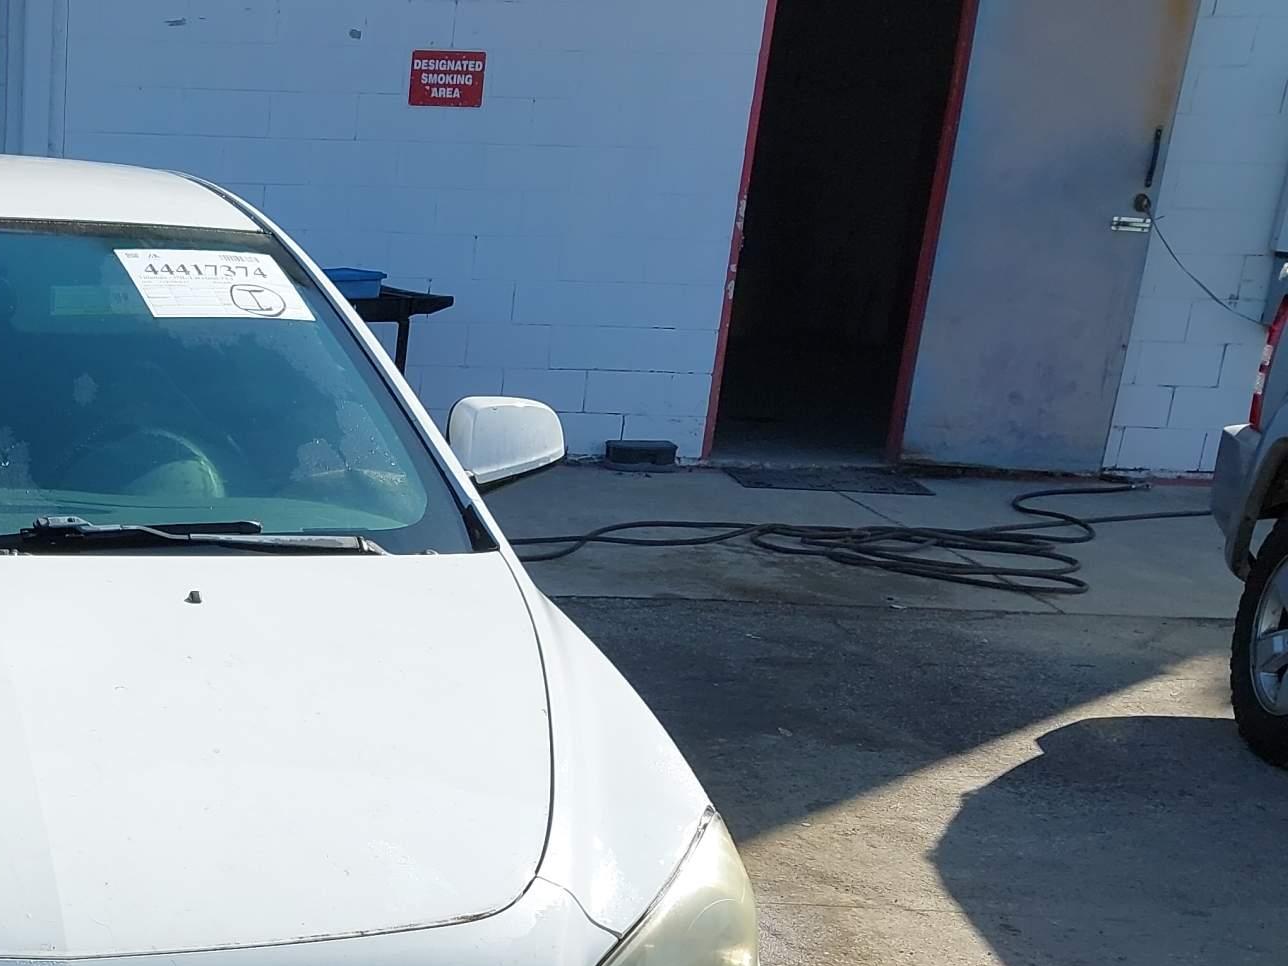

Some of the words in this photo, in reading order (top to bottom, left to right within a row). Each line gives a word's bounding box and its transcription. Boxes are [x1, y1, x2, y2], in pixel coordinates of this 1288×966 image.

[413, 59, 483, 72] DESIGNATED
[421, 73, 473, 85] SMOKING
[430, 87, 461, 98] AREA
[144, 263, 268, 278] 44417374
